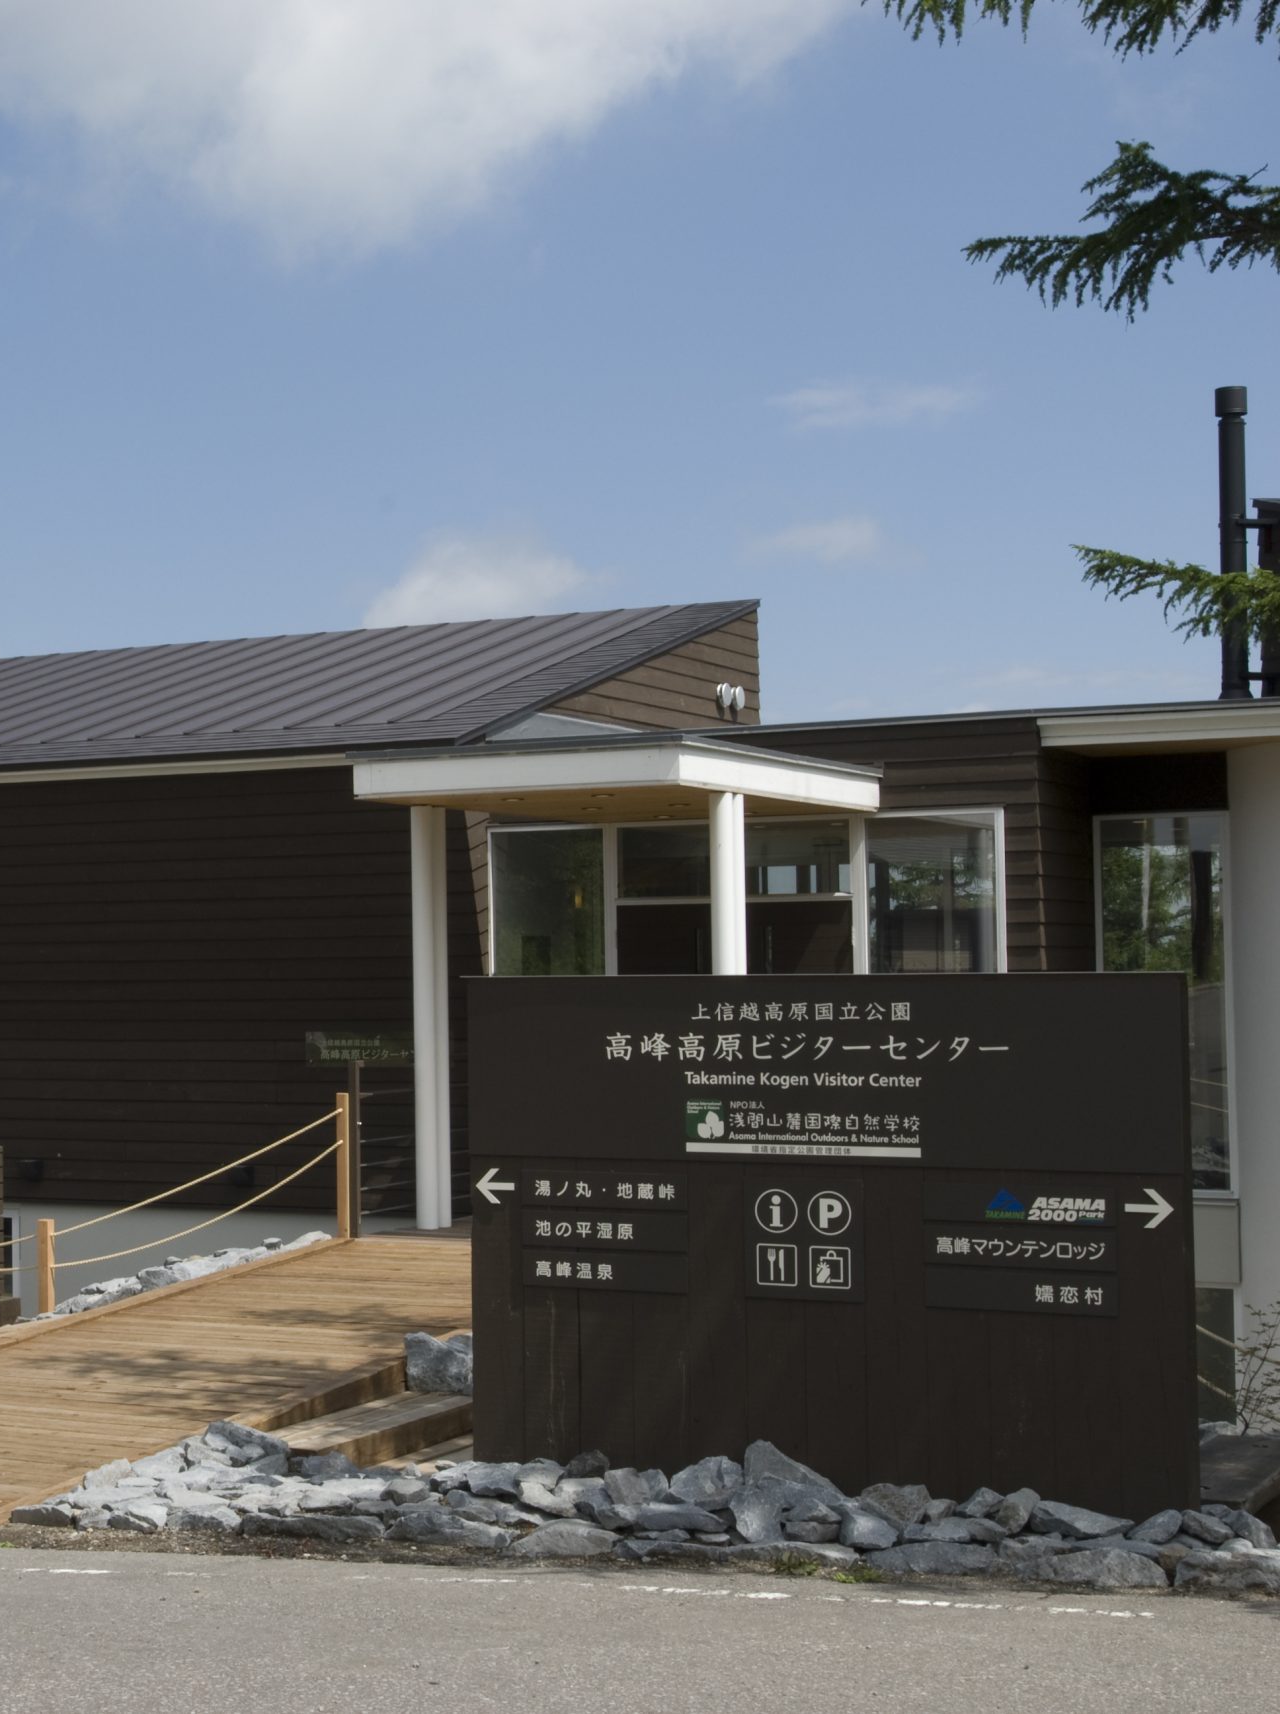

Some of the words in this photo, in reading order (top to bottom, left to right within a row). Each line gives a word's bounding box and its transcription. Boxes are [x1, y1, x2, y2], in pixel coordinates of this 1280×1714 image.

[691, 1002, 910, 1021] 上信越高原国立公園
[606, 1032, 1009, 1061] 高峰高原ビジターセンター
[684, 1071, 755, 1085] Takamine
[760, 1072, 808, 1089] Kogen
[813, 1072, 865, 1086] Visitor
[869, 1073, 922, 1087] Center
[729, 1112, 920, 1132] 浅間山麓国際自然学校
[728, 1131, 757, 1140] Asama
[758, 1132, 809, 1141] International
[810, 1132, 849, 1142] Outdoors
[851, 1134, 858, 1143] &
[860, 1134, 889, 1143] Nature
[892, 1134, 919, 1144] School
[535, 1180, 675, 1200] 湯ノ丸・地蔵峠
[819, 1198, 842, 1228] P
[1031, 1197, 1105, 1211] ASAMA
[1027, 1209, 1077, 1222] 2000
[1078, 1211, 1105, 1219] Park
[536, 1220, 633, 1240] 池の平湿原
[936, 1237, 1105, 1260] 高峰マウンテンロッジ
[536, 1260, 613, 1280] 高峰温泉
[1035, 1284, 1103, 1305] 嬬恋村
